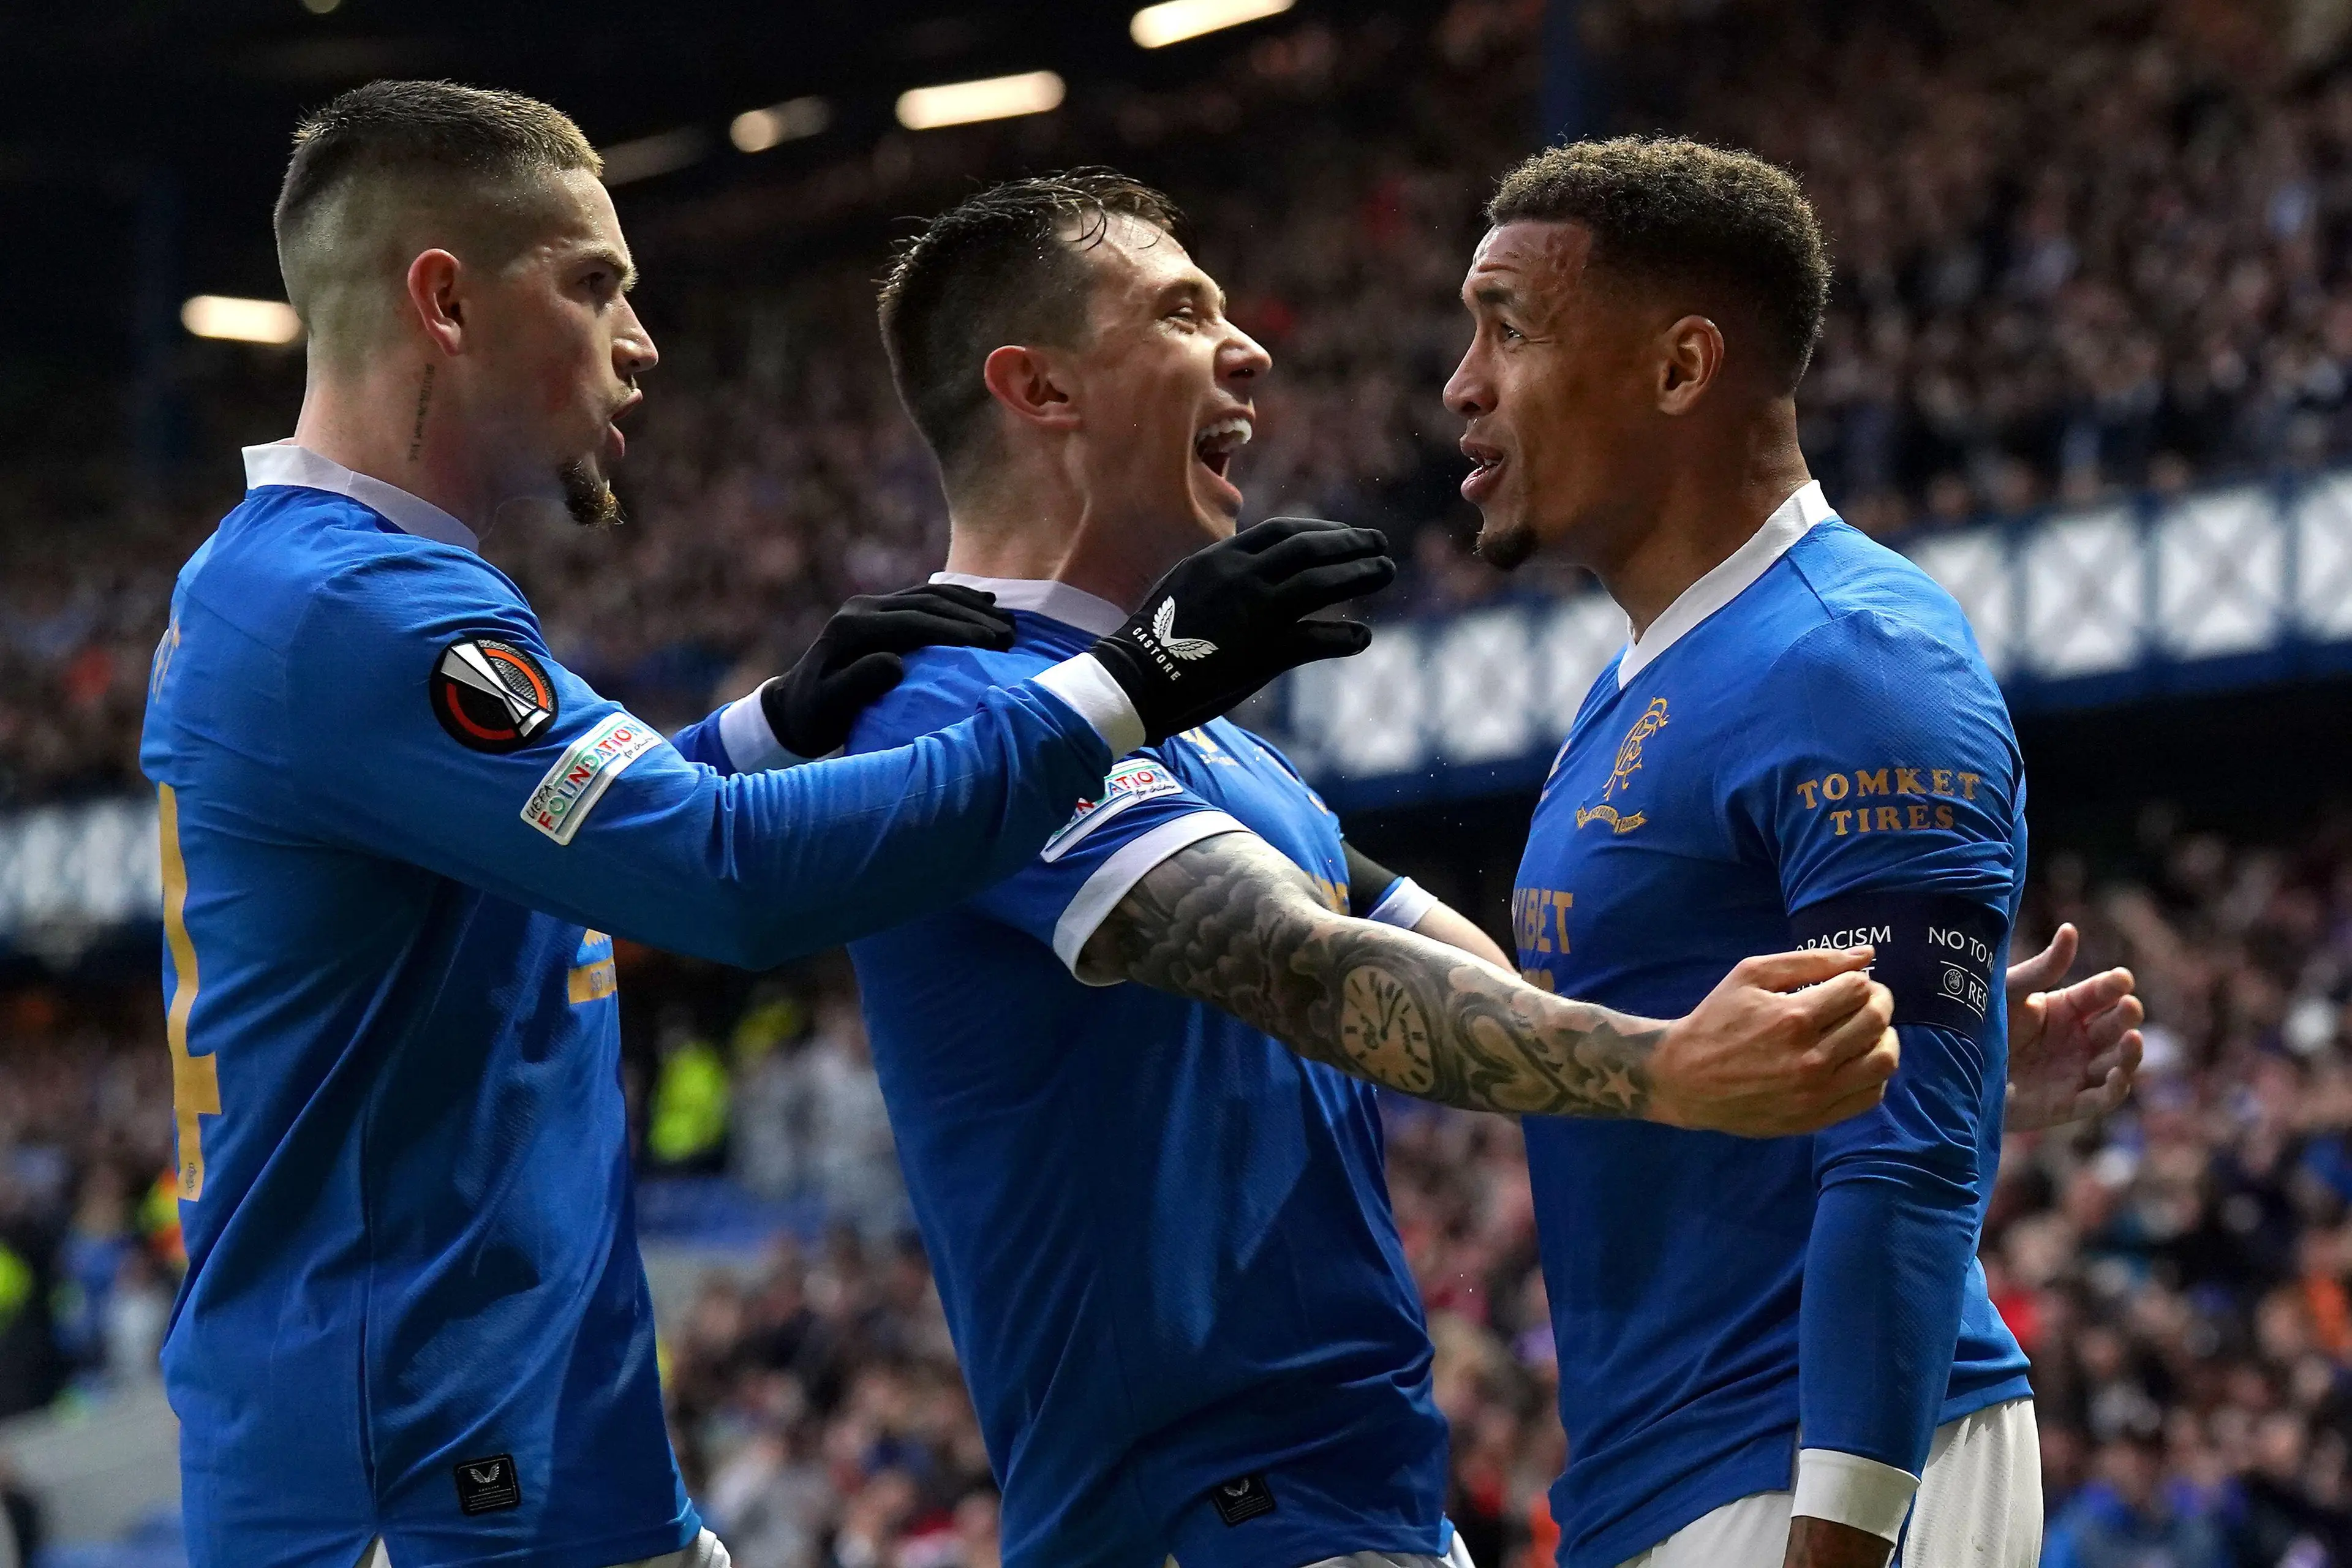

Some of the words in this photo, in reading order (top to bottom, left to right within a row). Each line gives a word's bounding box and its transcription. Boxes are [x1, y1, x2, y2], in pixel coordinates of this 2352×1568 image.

[1132, 627, 1182, 681] CASTORE
[537, 722, 644, 832] FOUNDATION
[1796, 767, 1980, 810] TOMKET
[526, 781, 554, 819] UEFA
[1829, 805, 1954, 836] TIRES
[1928, 926, 1964, 949] NO
[1969, 937, 1987, 963] TO
